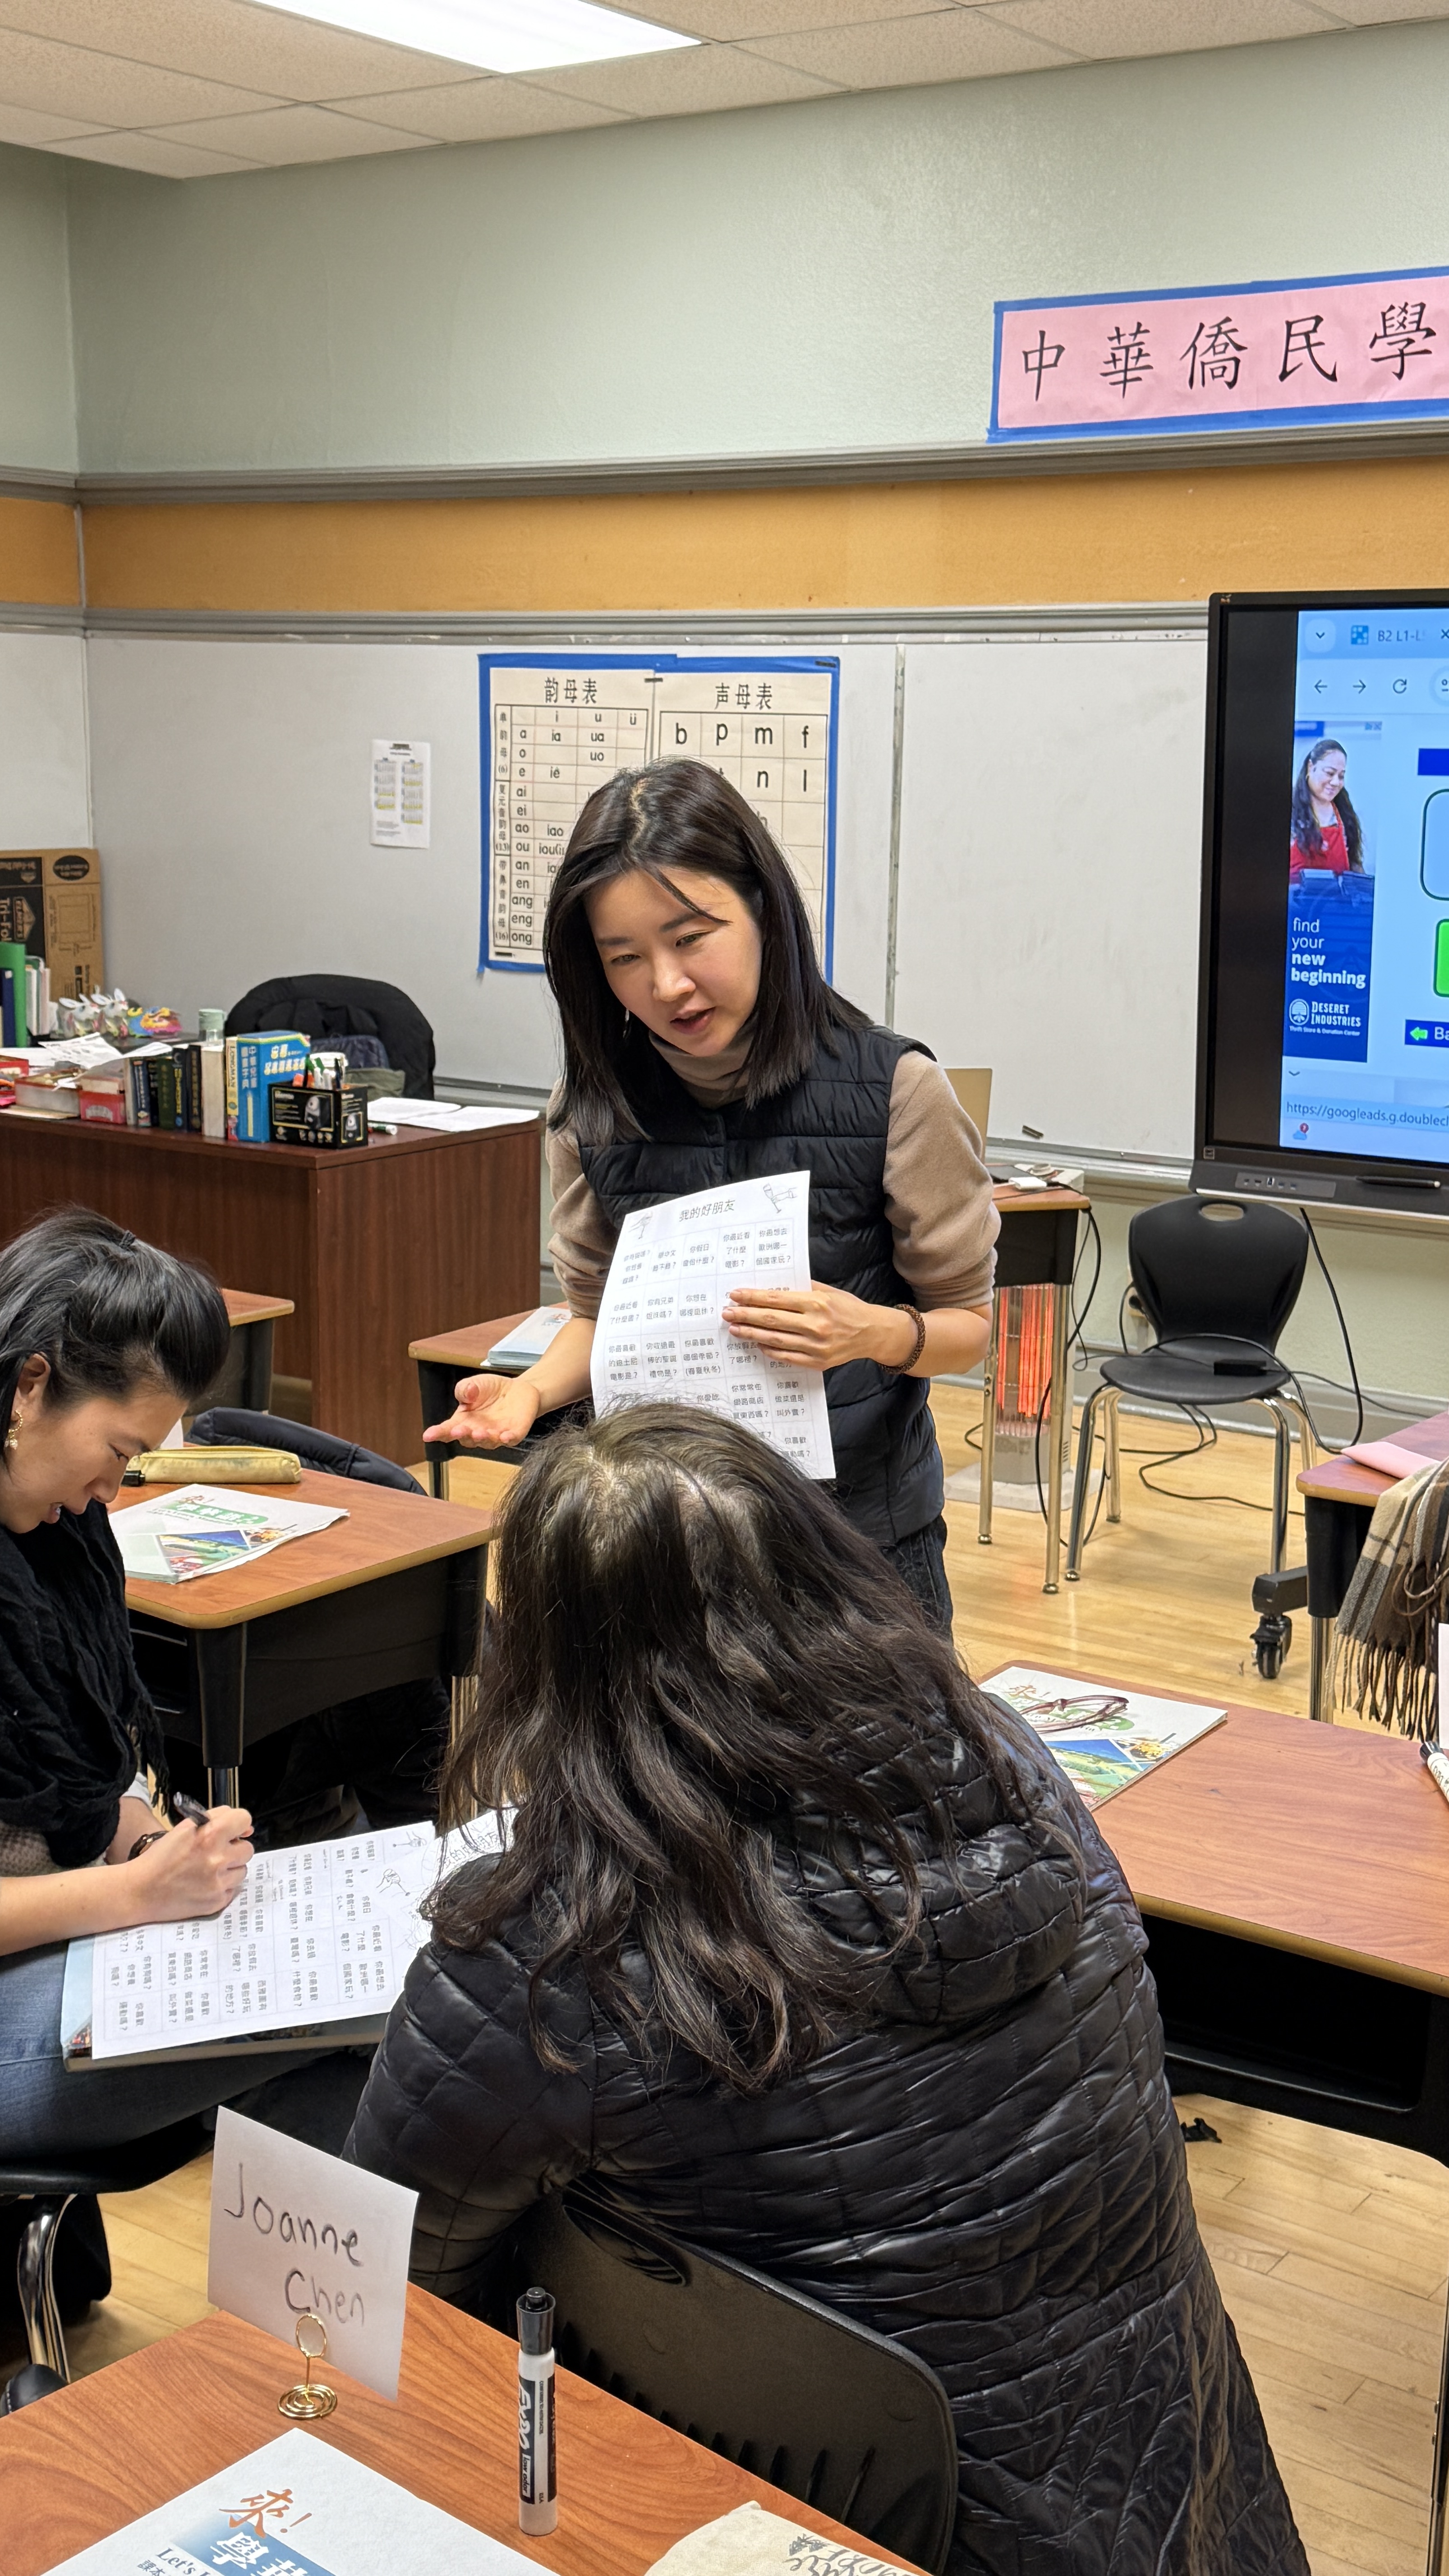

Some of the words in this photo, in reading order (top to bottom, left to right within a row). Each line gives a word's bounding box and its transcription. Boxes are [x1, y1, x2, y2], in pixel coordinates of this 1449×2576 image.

[1021, 301, 1437, 402] 中華僑民學
[1378, 630, 1392, 642] B2
[544, 677, 598, 704] 韵母表
[714, 683, 773, 710] 声母表
[555, 710, 559, 722] i
[595, 713, 603, 722] u
[630, 713, 637, 725] ü
[520, 730, 527, 739] a
[551, 729, 561, 742] ia
[591, 732, 605, 742] ua
[675, 722, 688, 745] b
[716, 723, 728, 745] p
[754, 727, 773, 745] m
[801, 725, 810, 748] f
[519, 749, 527, 758] o
[590, 752, 605, 762] uo
[519, 768, 526, 777] e
[757, 770, 769, 788] n
[516, 786, 527, 797] ai
[517, 804, 527, 816] ei
[515, 823, 529, 833] ao
[547, 824, 564, 837] iao
[515, 842, 530, 852] ou
[515, 860, 529, 871] an
[515, 879, 529, 889] en
[512, 896, 533, 909] ang
[511, 915, 533, 927] eng
[1293, 917, 1320, 933] find
[511, 933, 532, 946] ong
[1292, 937, 1325, 951] your
[1292, 953, 1326, 966] new
[1291, 967, 1366, 989] beginning
[224, 2162, 364, 2267] Joanne
[285, 2268, 365, 2327] Chen
[522, 2456, 530, 2473] low
[521, 2473, 530, 2493] odor
[156, 2547, 197, 2576] Let's
